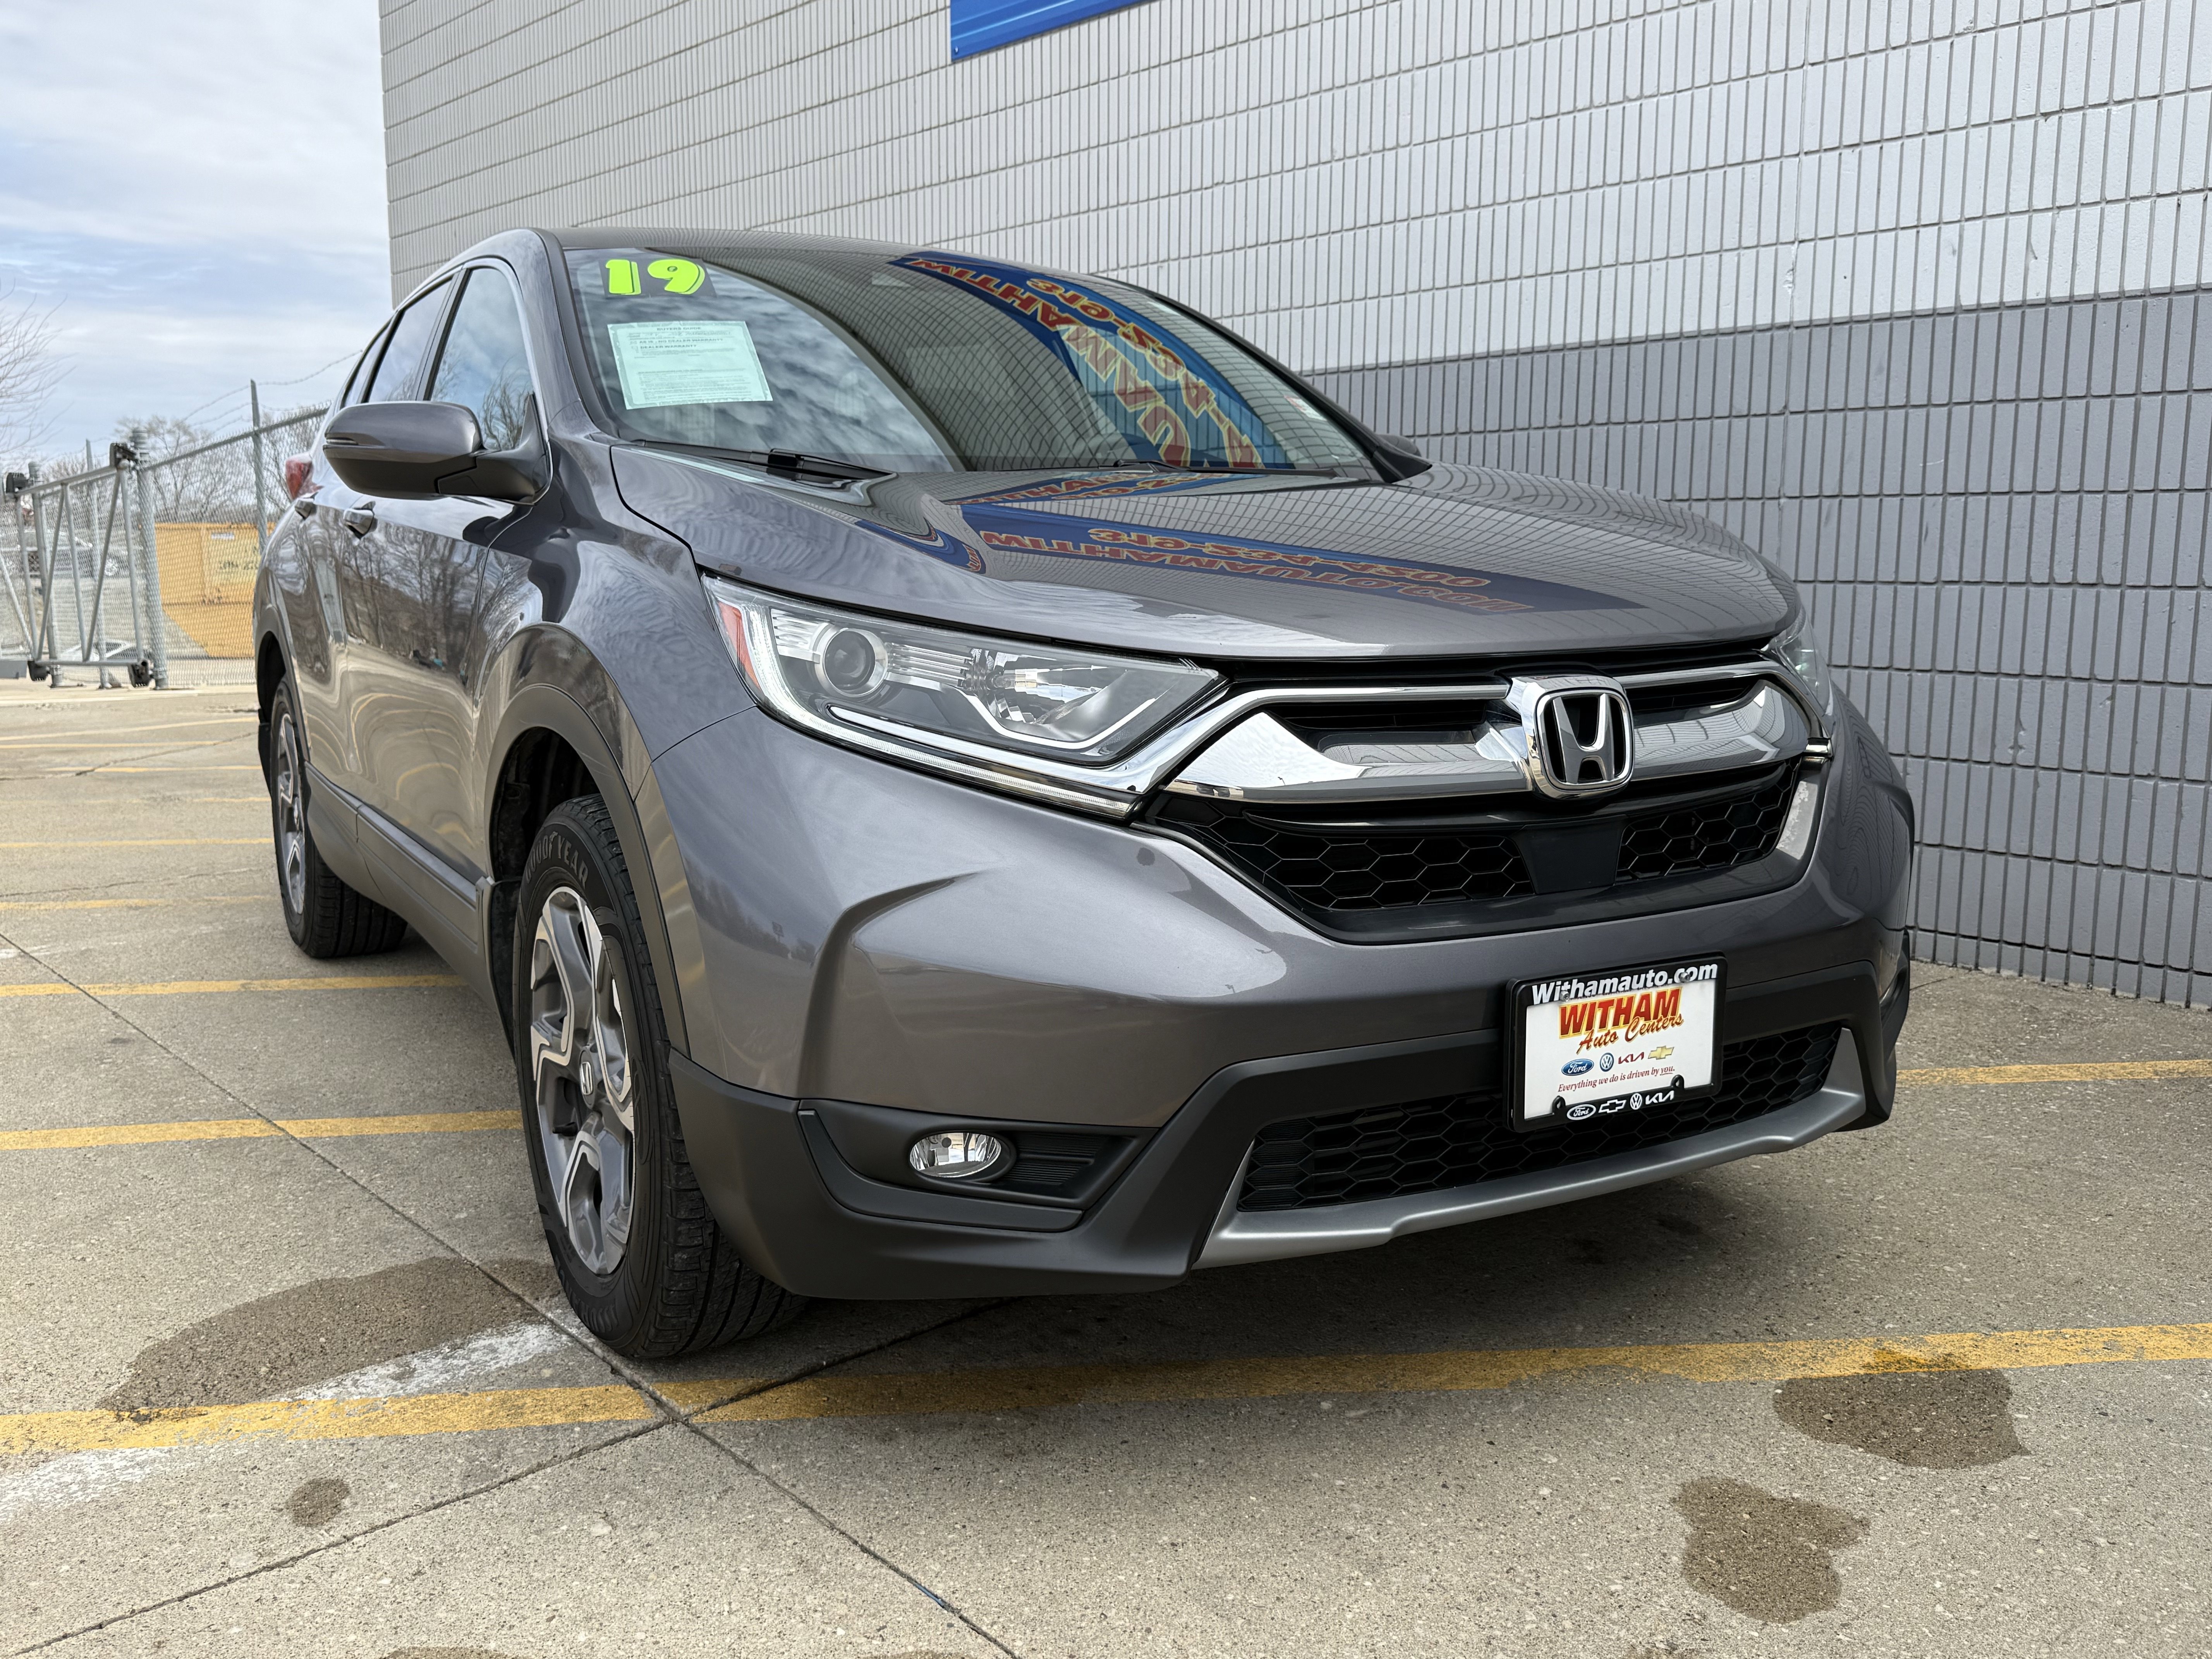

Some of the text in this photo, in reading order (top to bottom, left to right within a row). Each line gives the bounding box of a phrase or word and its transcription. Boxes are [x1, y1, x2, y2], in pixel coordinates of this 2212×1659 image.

[605, 258, 705, 295] 19
[526, 832, 588, 890] GOODYEAR
[1532, 963, 1718, 1005] Withamauto.com
[1559, 987, 1682, 1039] WITHAM
[1576, 1013, 1684, 1054] Auto Centers
[1558, 1079, 1597, 1092] Everything
[1609, 1074, 1618, 1083] do
[1627, 1070, 1650, 1080] driven
[1651, 1067, 1659, 1075] by
[1568, 1064, 1587, 1073] Ford
